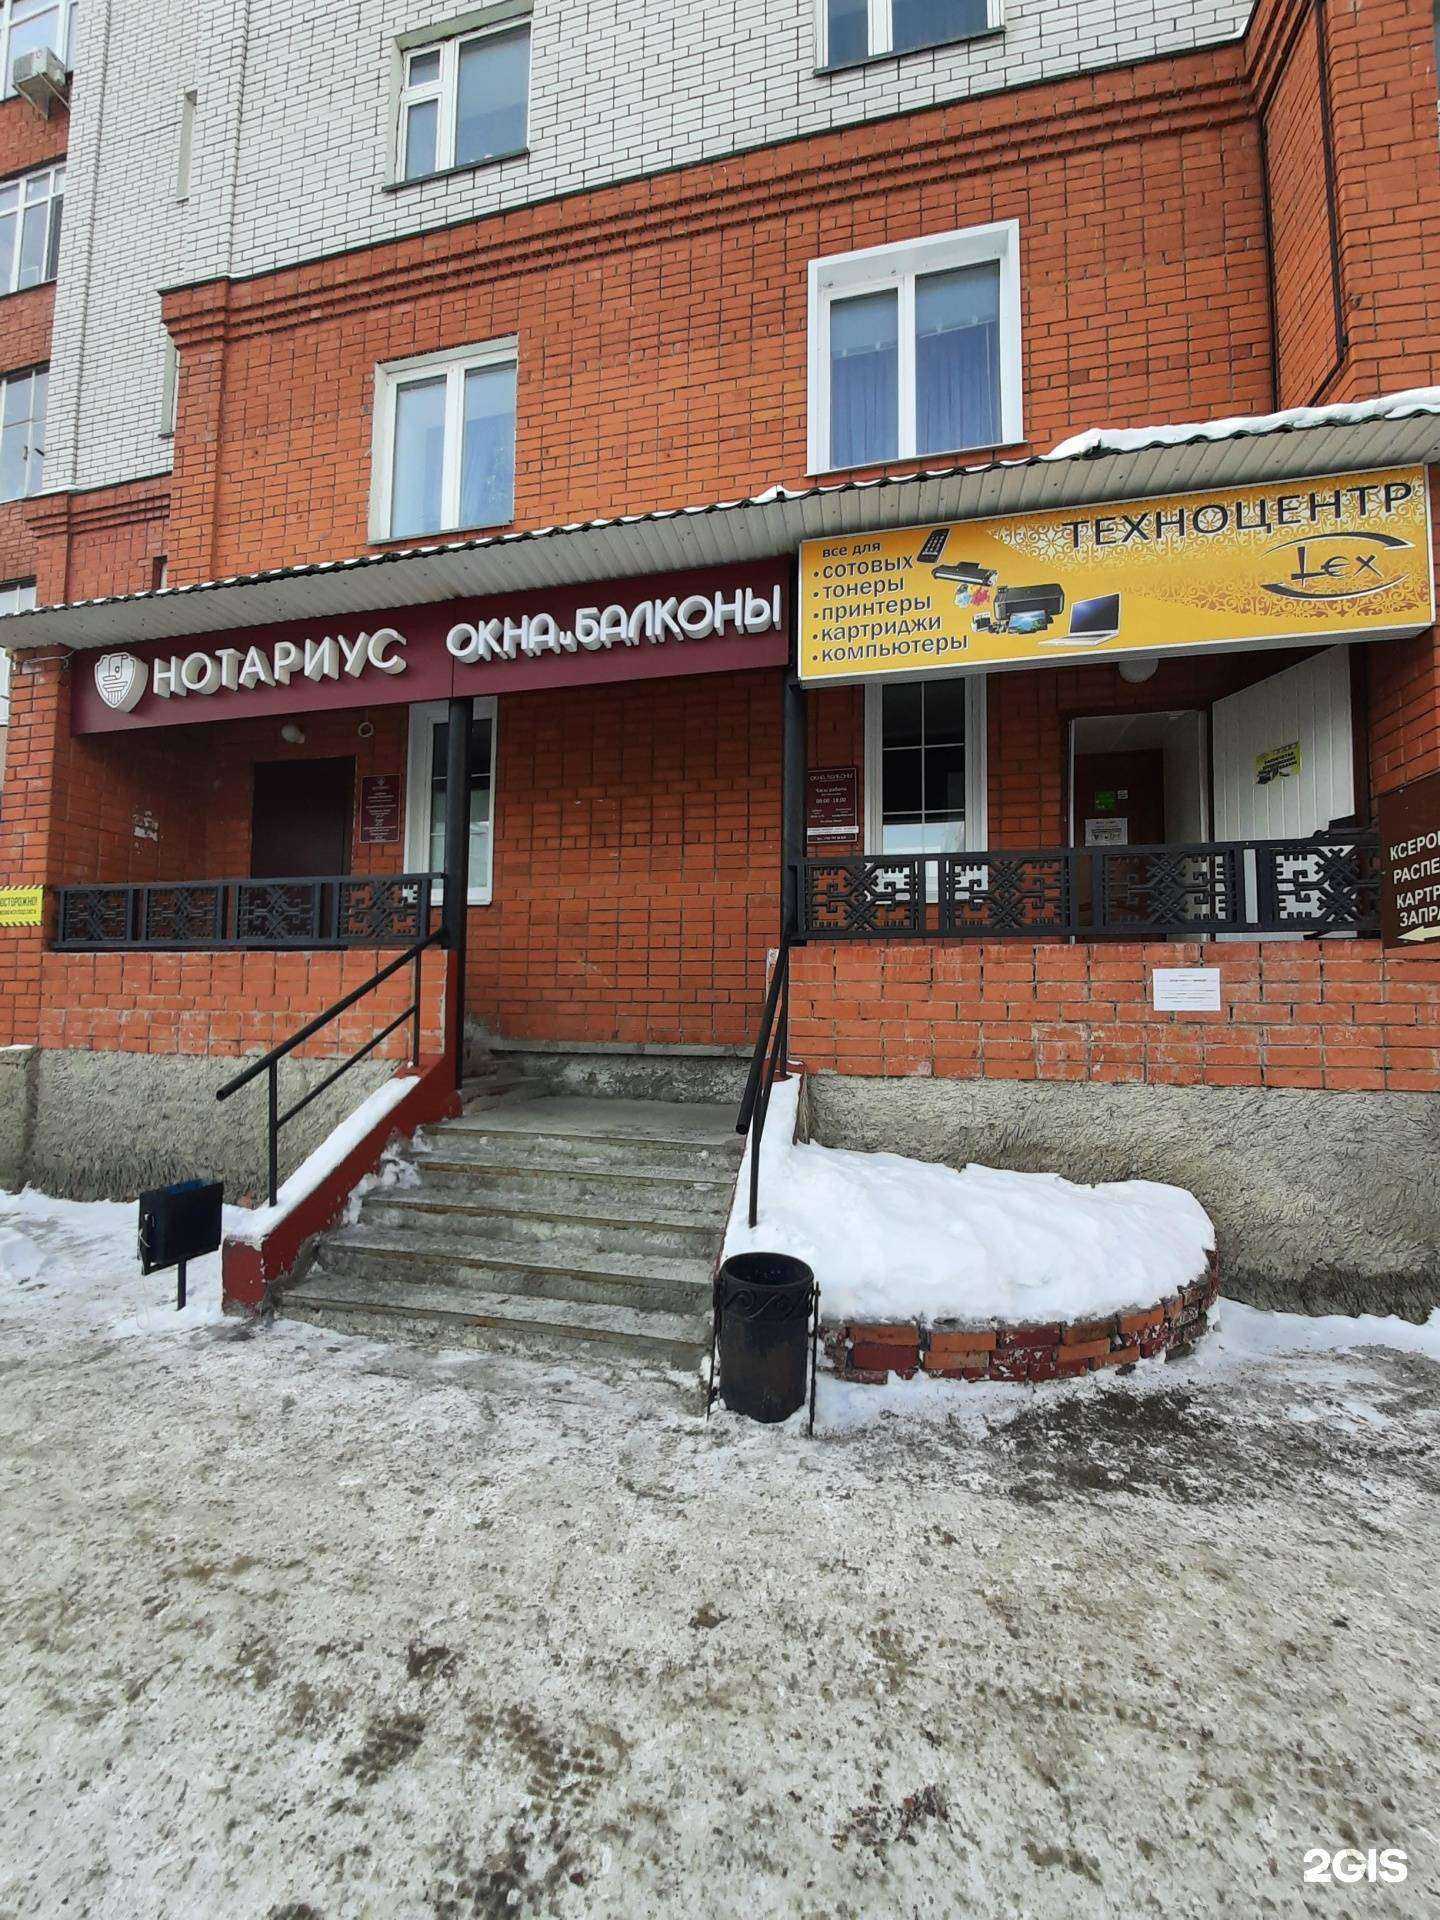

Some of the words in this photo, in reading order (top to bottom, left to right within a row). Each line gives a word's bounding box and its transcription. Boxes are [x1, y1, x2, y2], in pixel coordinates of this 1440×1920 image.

[1062, 482, 1413, 549] ТЕХНОЦЕНТР
[822, 546, 848, 558] все
[852, 541, 881, 557] для
[822, 553, 914, 579] сотовых
[822, 576, 905, 600] тонеры
[821, 595, 932, 623] принтеры
[446, 612, 562, 663] ОКНА
[574, 584, 782, 651] БАЛКОНЫ
[821, 616, 942, 644] картриджи
[153, 627, 408, 698] НОТАРИУС
[821, 633, 969, 664] компьютеры
